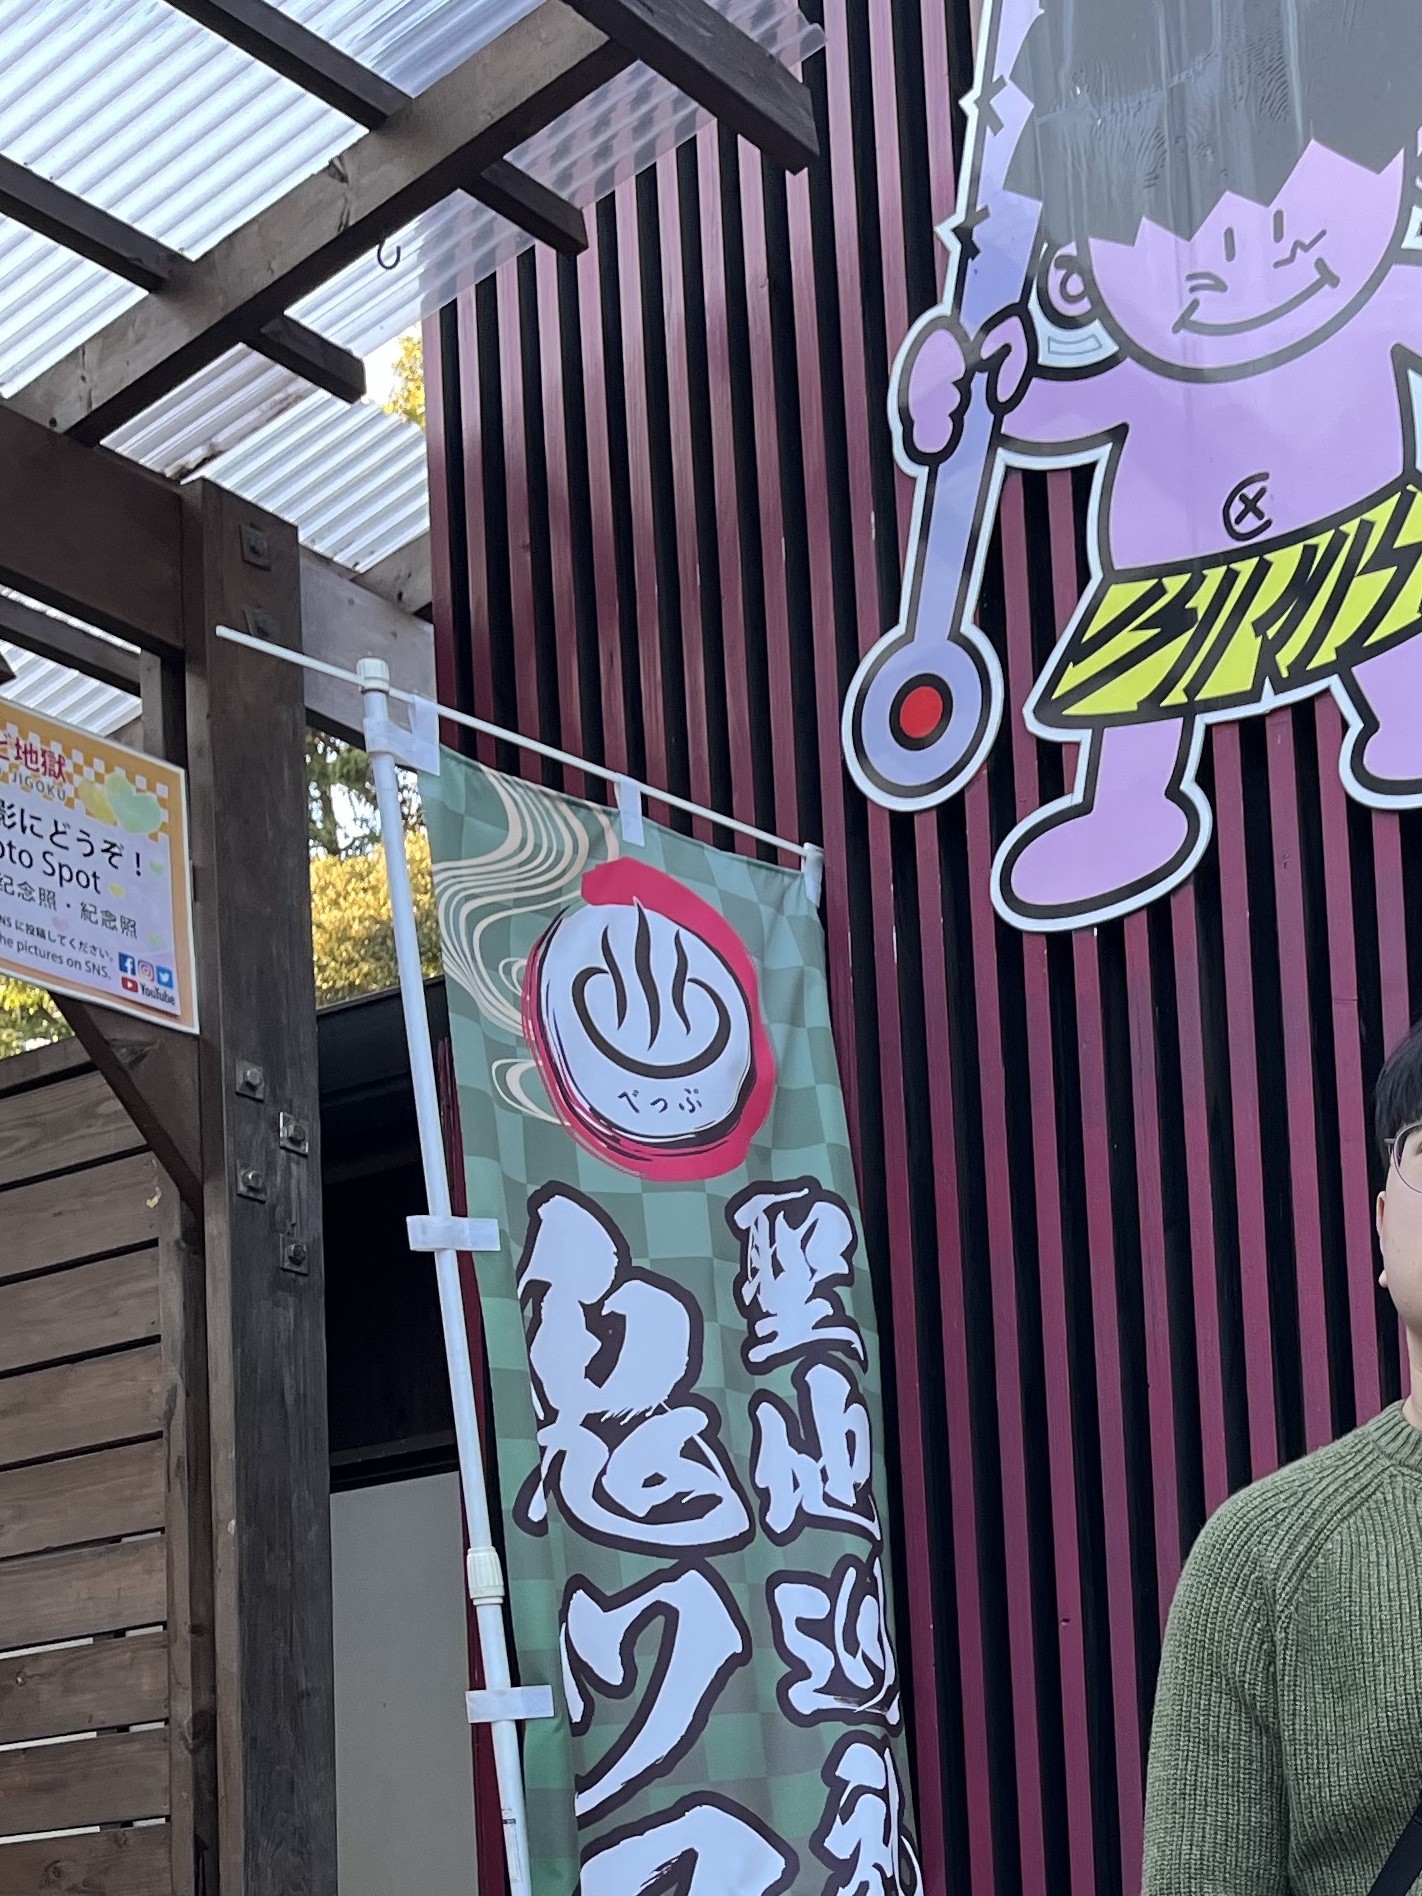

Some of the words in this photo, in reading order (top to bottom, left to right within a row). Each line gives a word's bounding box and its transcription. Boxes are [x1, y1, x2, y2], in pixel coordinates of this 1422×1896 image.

[12, 771, 66, 801] JIGOKU
[42, 850, 101, 895] Spot
[17, 941, 63, 965] pictures
[67, 957, 82, 971] on
[85, 960, 112, 980] SNS.
[140, 982, 175, 1006] YouTube
